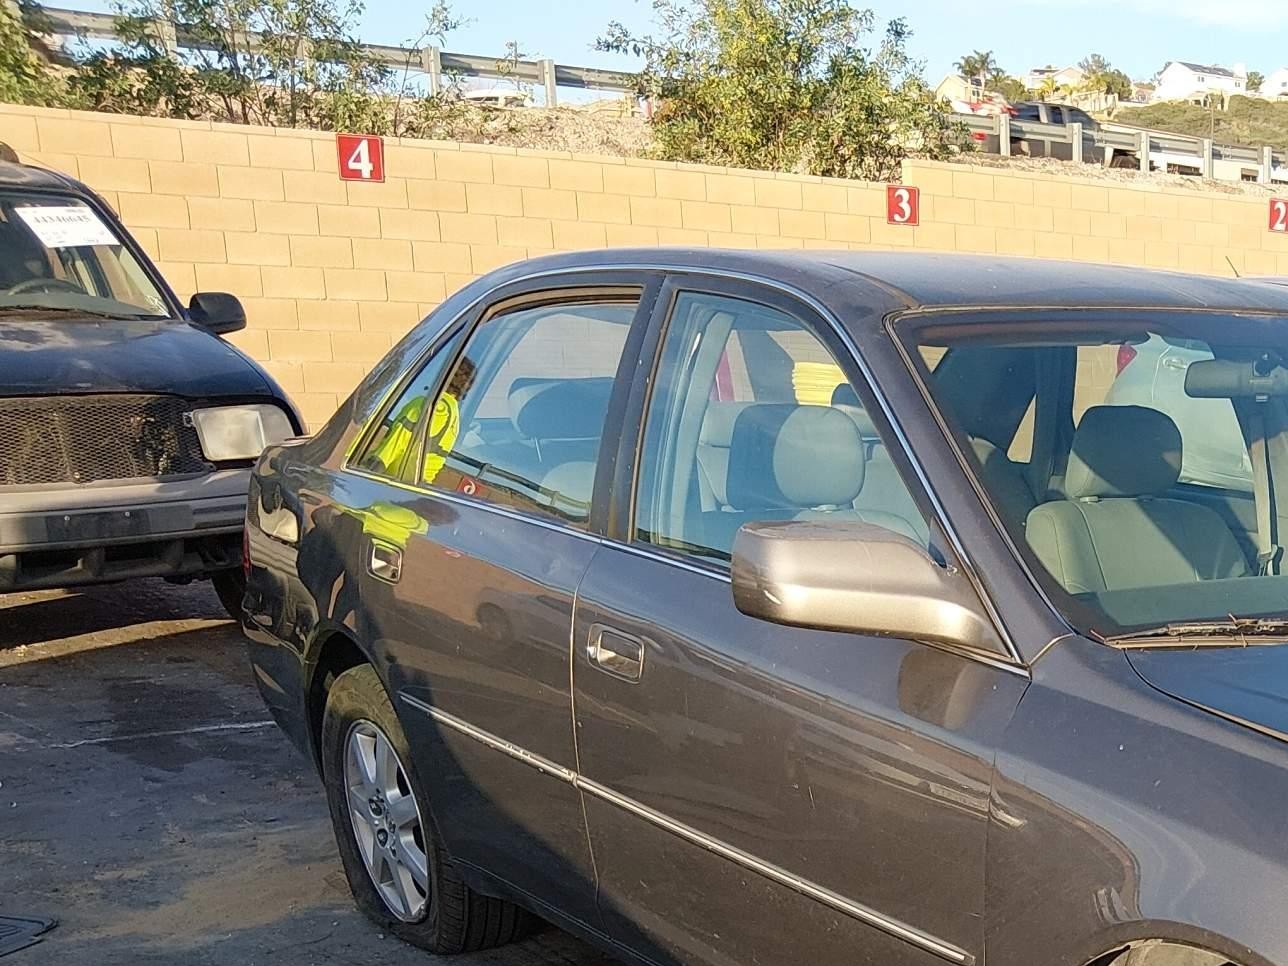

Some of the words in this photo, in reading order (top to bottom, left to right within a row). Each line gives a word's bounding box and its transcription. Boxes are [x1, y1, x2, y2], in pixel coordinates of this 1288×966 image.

[347, 138, 374, 179] 4
[893, 188, 911, 222] 3
[1272, 201, 1287, 231] 2
